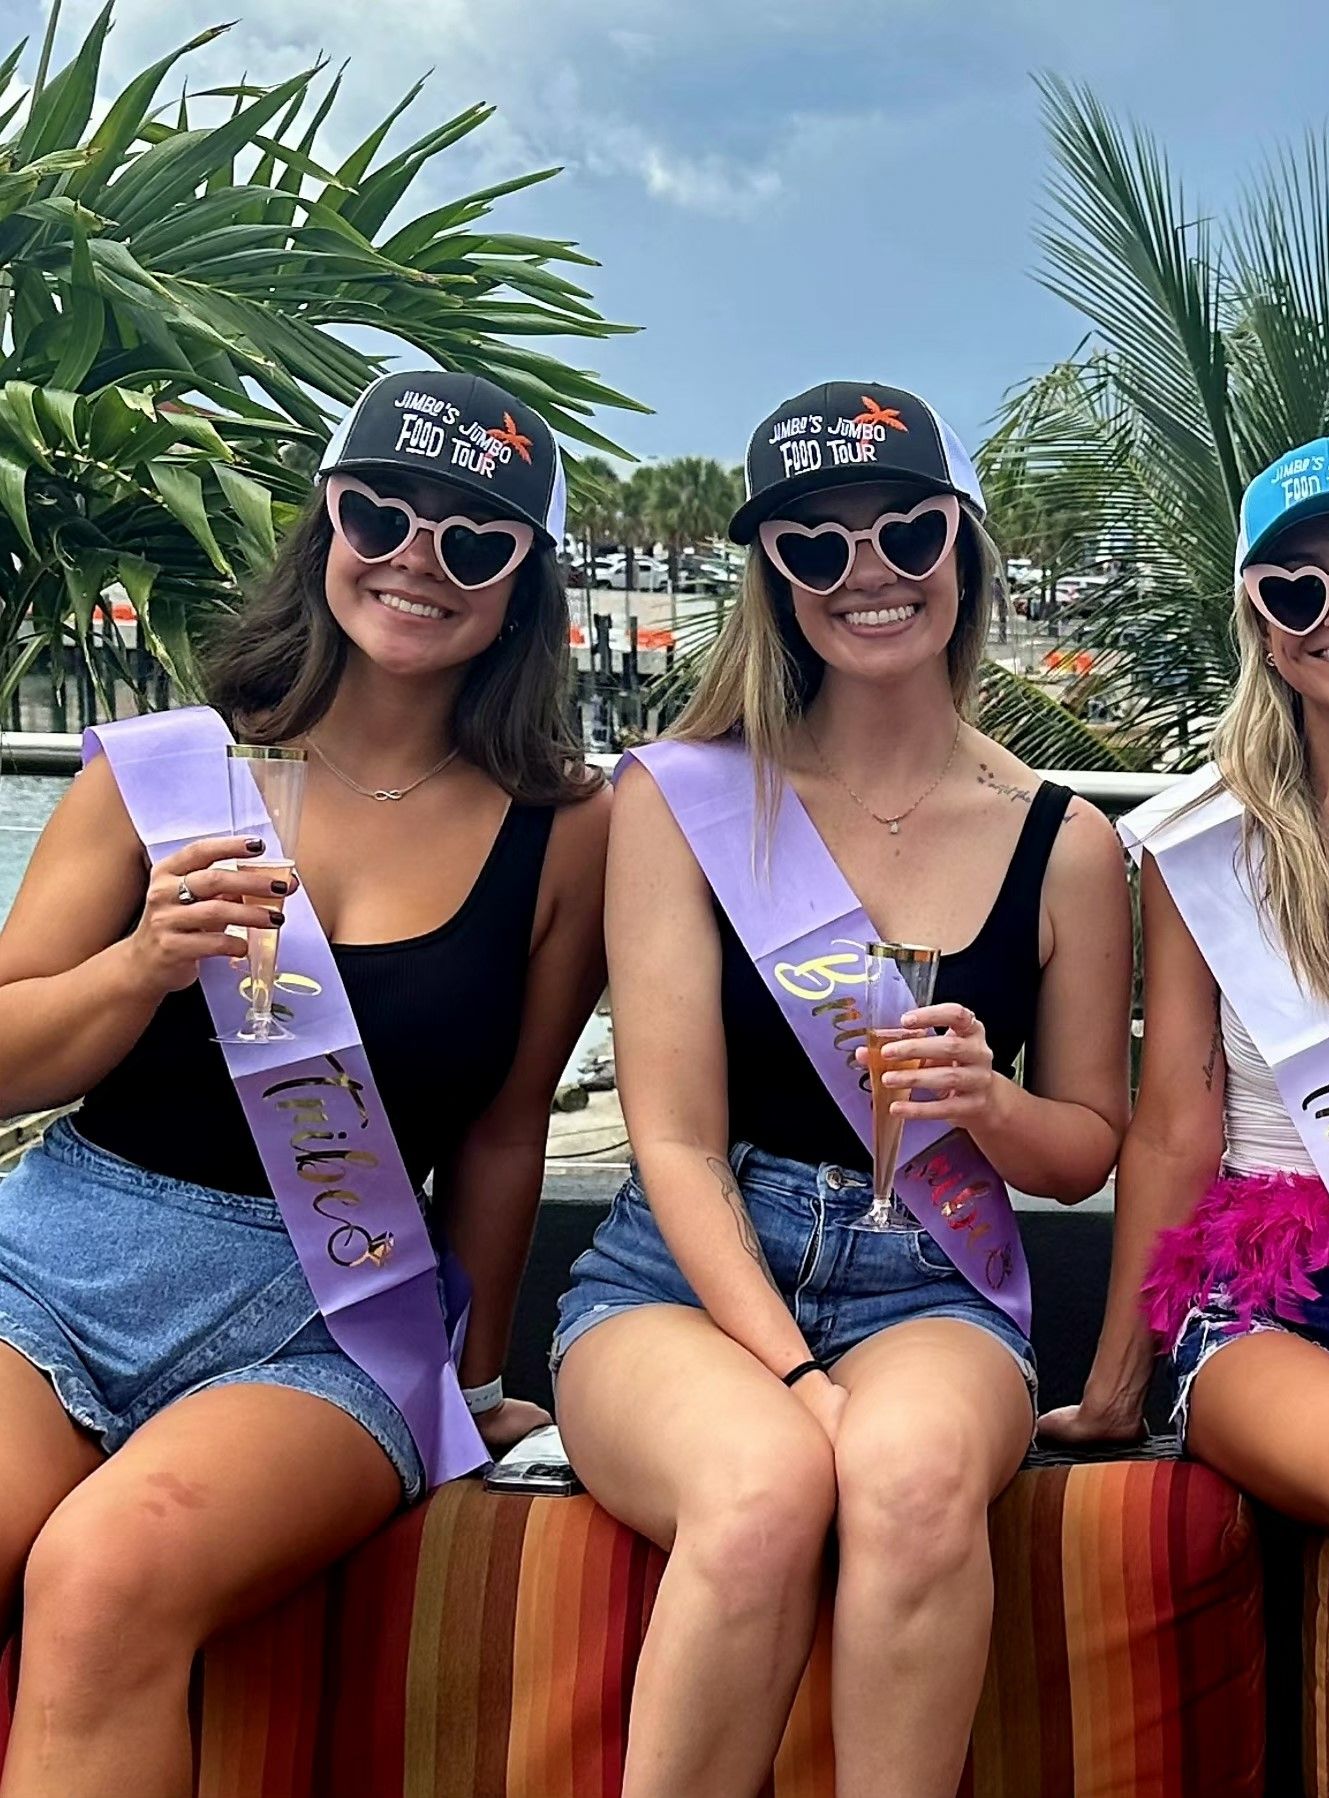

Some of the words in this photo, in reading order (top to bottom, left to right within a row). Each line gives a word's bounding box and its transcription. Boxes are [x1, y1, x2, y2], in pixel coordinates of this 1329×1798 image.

[394, 390, 461, 425] JIMBO'S
[395, 413, 445, 458] FOOD
[450, 437, 496, 479] TOUR
[768, 414, 824, 445] JIMBO'S
[779, 439, 823, 479] FOOD
[826, 438, 878, 466] TOUR
[1281, 475, 1323, 510] FOOD
